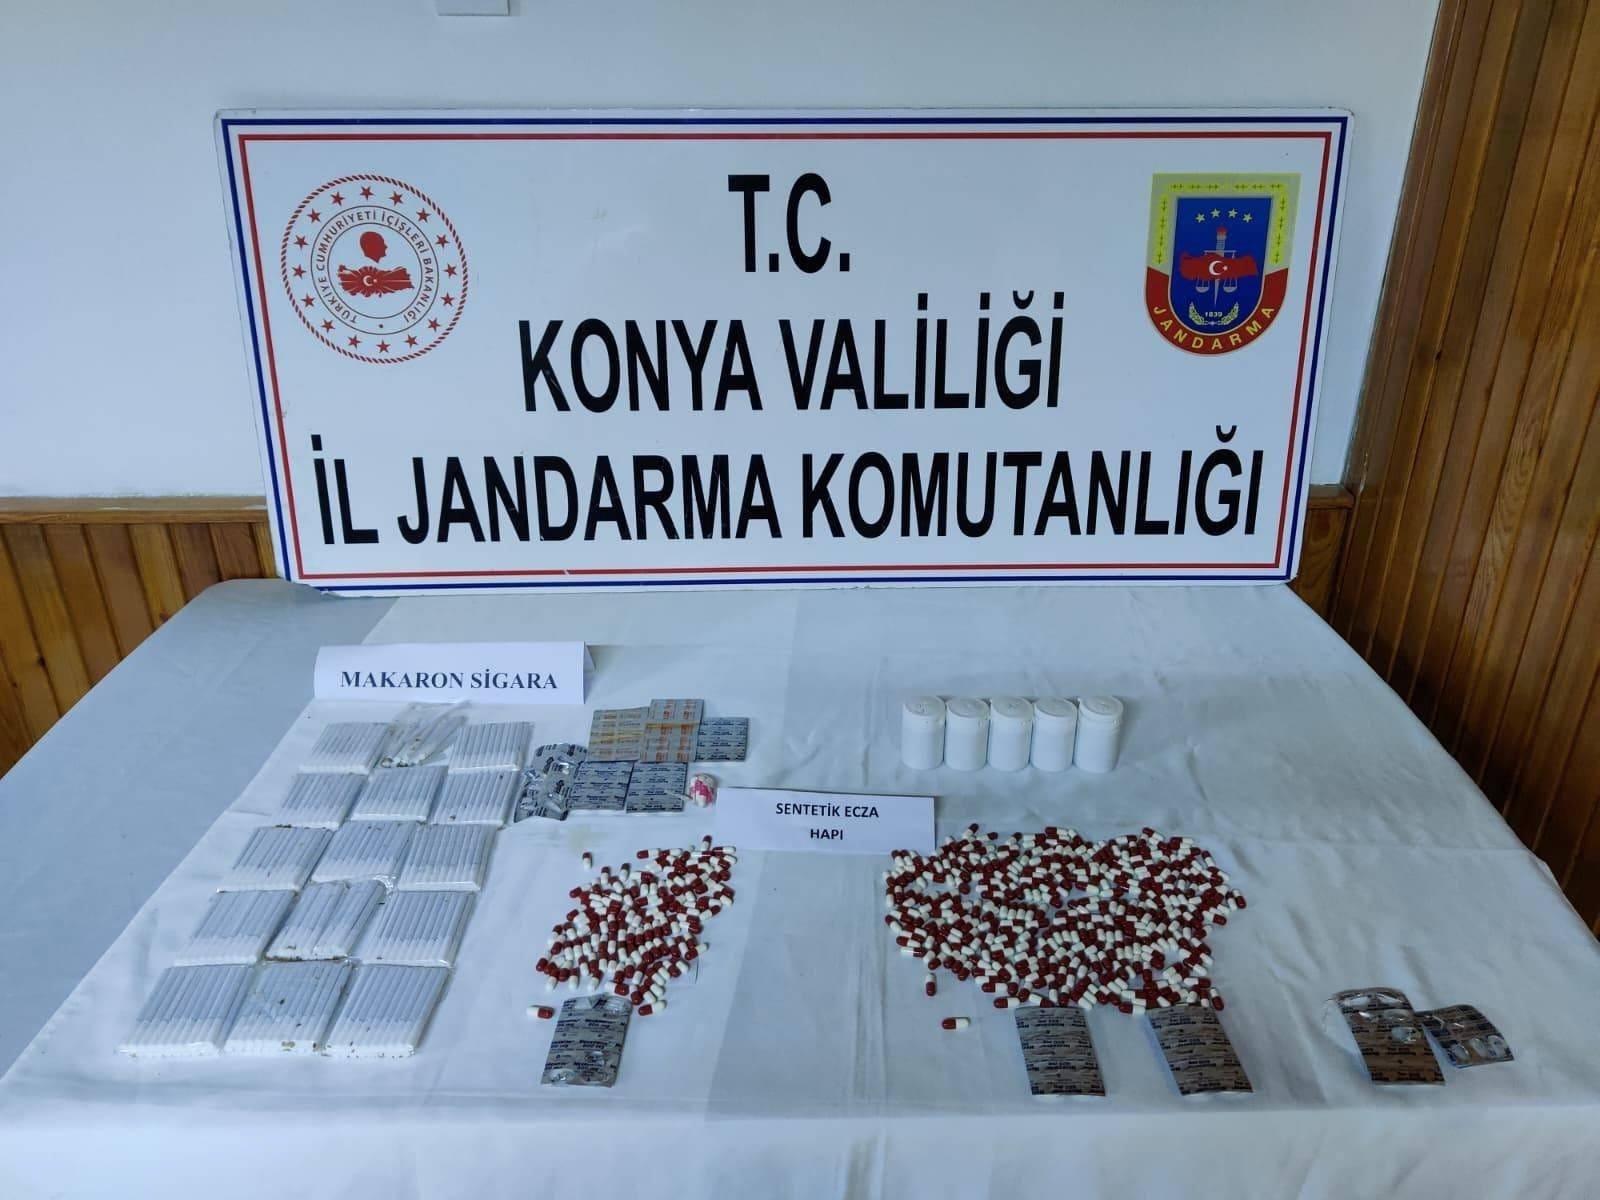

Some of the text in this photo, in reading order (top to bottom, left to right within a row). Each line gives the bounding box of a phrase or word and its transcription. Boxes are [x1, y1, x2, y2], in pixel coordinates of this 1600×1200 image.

[727, 173, 851, 274] T.C.
[315, 209, 436, 324] TÜRKİYE CUMHURİYETİ İÇİŞLERİ BAKANLIĞI
[518, 290, 1065, 414] KONYA VALİLİĞİ
[1153, 305, 1275, 350] JANDARMA
[310, 424, 1264, 546] İL JANDARMA KOMUTANLIĞI
[340, 668, 558, 690] MAKARON SİGARA
[775, 801, 880, 819] SENTETİK ECZA
[809, 828, 844, 842] HAPI
